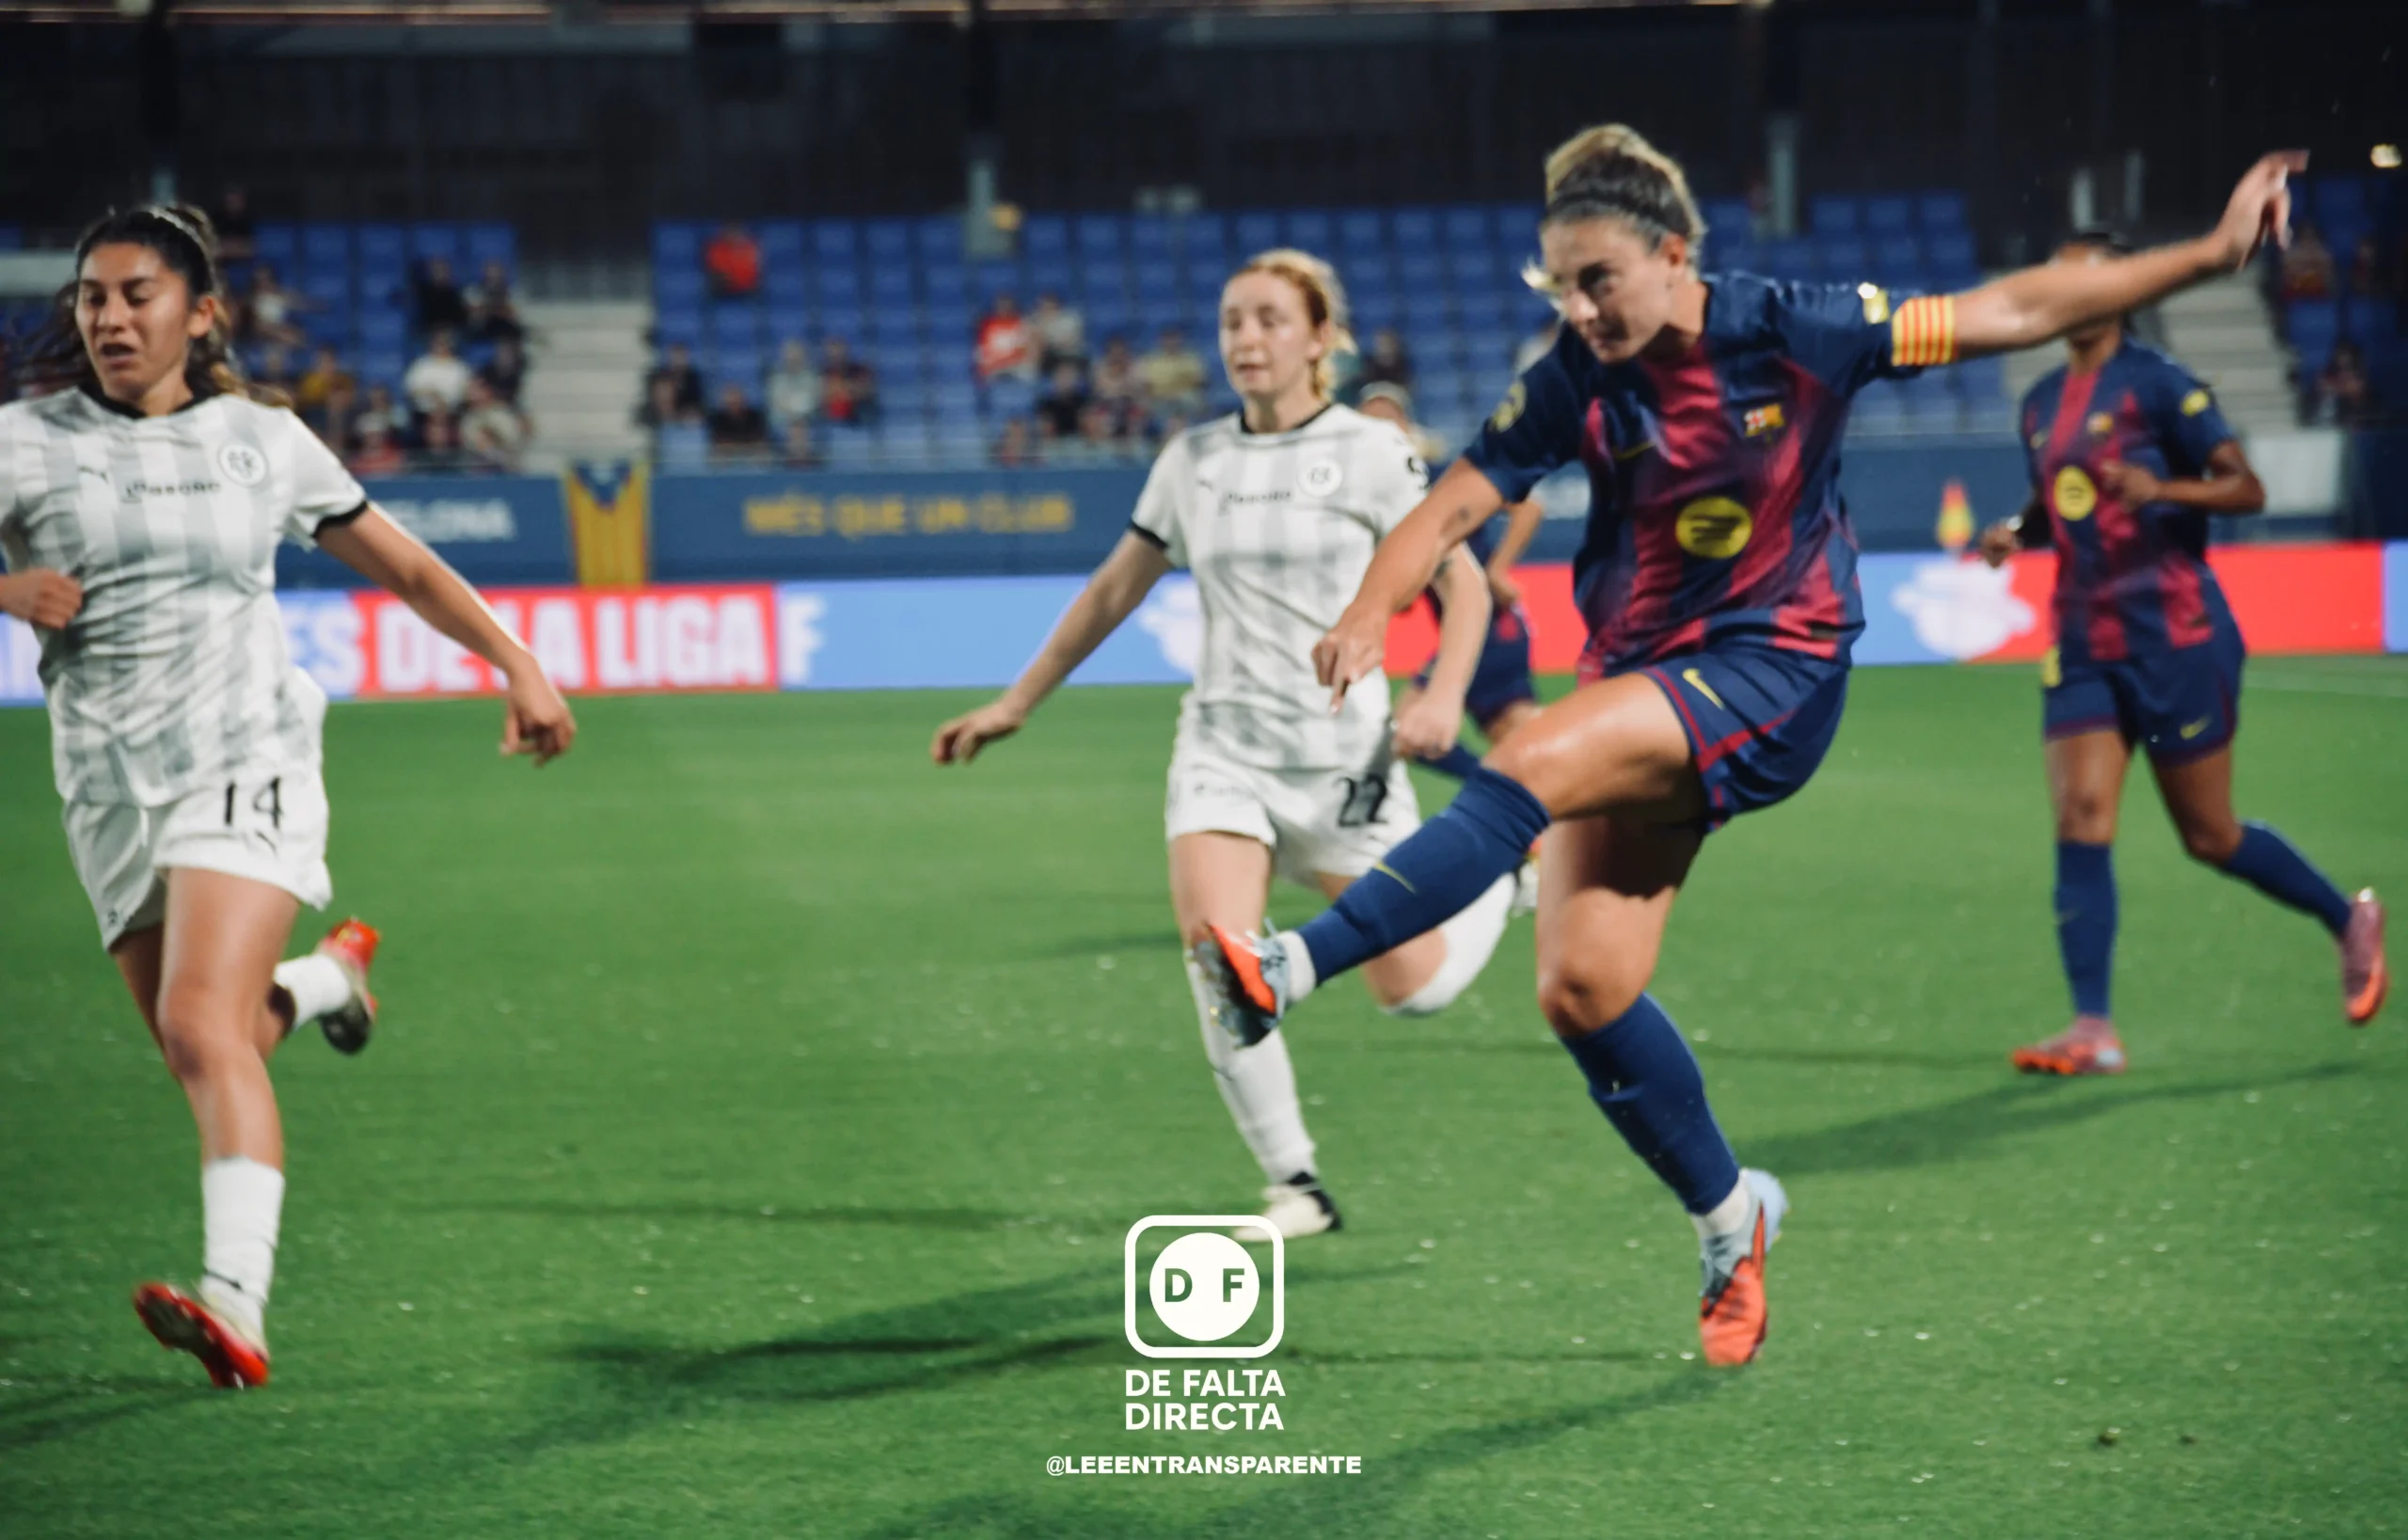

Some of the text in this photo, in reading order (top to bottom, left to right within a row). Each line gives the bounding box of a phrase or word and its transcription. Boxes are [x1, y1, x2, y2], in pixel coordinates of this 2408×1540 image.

[594, 594, 770, 689] LIGA
[780, 595, 827, 685] F
[225, 776, 283, 829] 14
